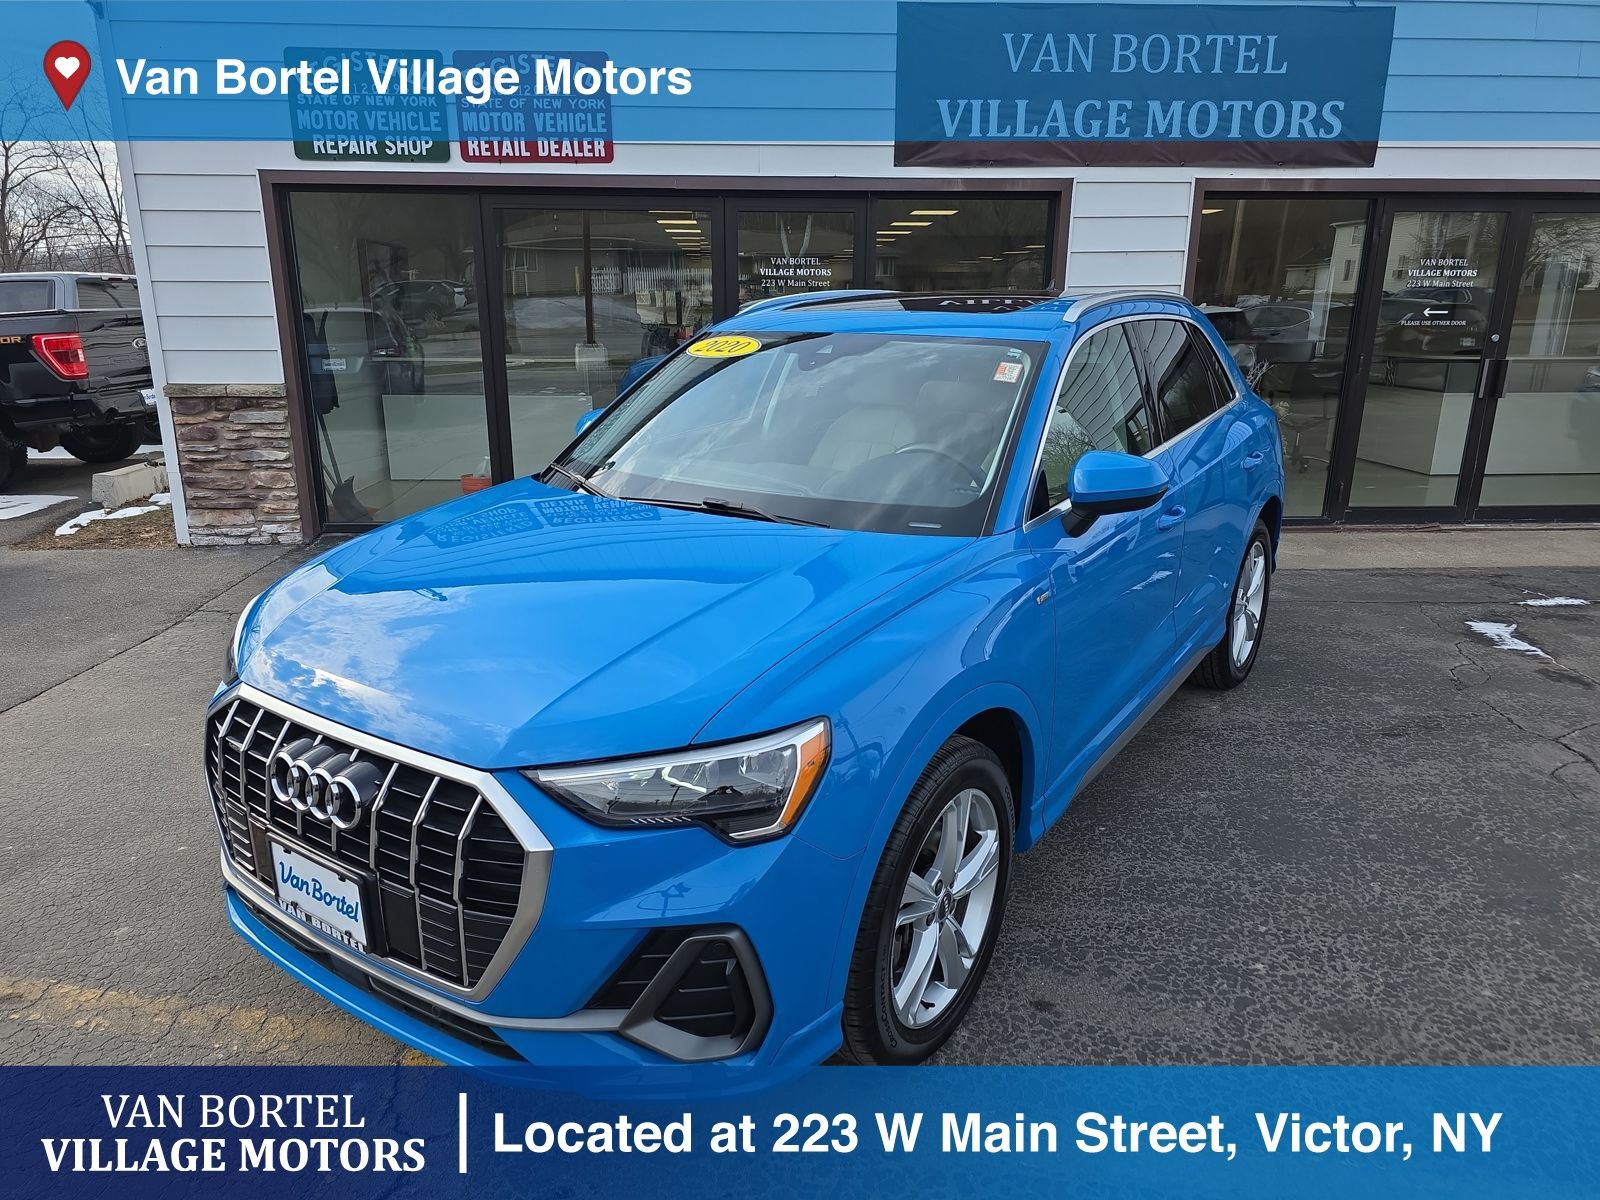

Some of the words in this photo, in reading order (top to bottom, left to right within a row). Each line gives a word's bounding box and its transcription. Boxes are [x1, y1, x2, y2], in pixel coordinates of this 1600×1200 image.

[1002, 33, 1097, 73] VAN
[1110, 33, 1288, 74] BORTEL
[296, 94, 339, 105] STATE
[344, 95, 362, 106] OF
[366, 96, 396, 107] NEW
[401, 97, 437, 107] YORK
[509, 98, 527, 109] OF
[533, 98, 562, 109] NEW
[568, 98, 606, 109] YORK
[297, 109, 359, 131] MOTOR
[364, 110, 442, 132] VEHICLE
[462, 111, 526, 132] MOTOR
[533, 112, 608, 133] VEHICLE
[935, 99, 1133, 138] VILLAGE
[1143, 100, 1345, 139] MOTORS
[312, 134, 378, 155] REPAIR
[385, 136, 433, 156] SHOP
[467, 136, 531, 157] RETAIL
[537, 136, 606, 157] DEALER
[770, 257, 788, 265] VAN
[789, 257, 821, 265] BORTEL
[1420, 258, 1437, 266] VAN
[1438, 258, 1469, 266] BORTEL
[760, 268, 795, 276] VILLAGE
[796, 268, 832, 276] MOTORS
[1408, 269, 1441, 277] VILLAGE
[1442, 269, 1478, 277] MOTORS
[761, 279, 776, 287] 223
[777, 279, 786, 287] W
[787, 279, 806, 287] Main
[807, 279, 831, 287] Street
[1406, 280, 1421, 288] 223
[1422, 280, 1431, 288] W
[1432, 280, 1450, 288] Main
[1451, 280, 1474, 288] Street
[694, 340, 752, 354] 2020
